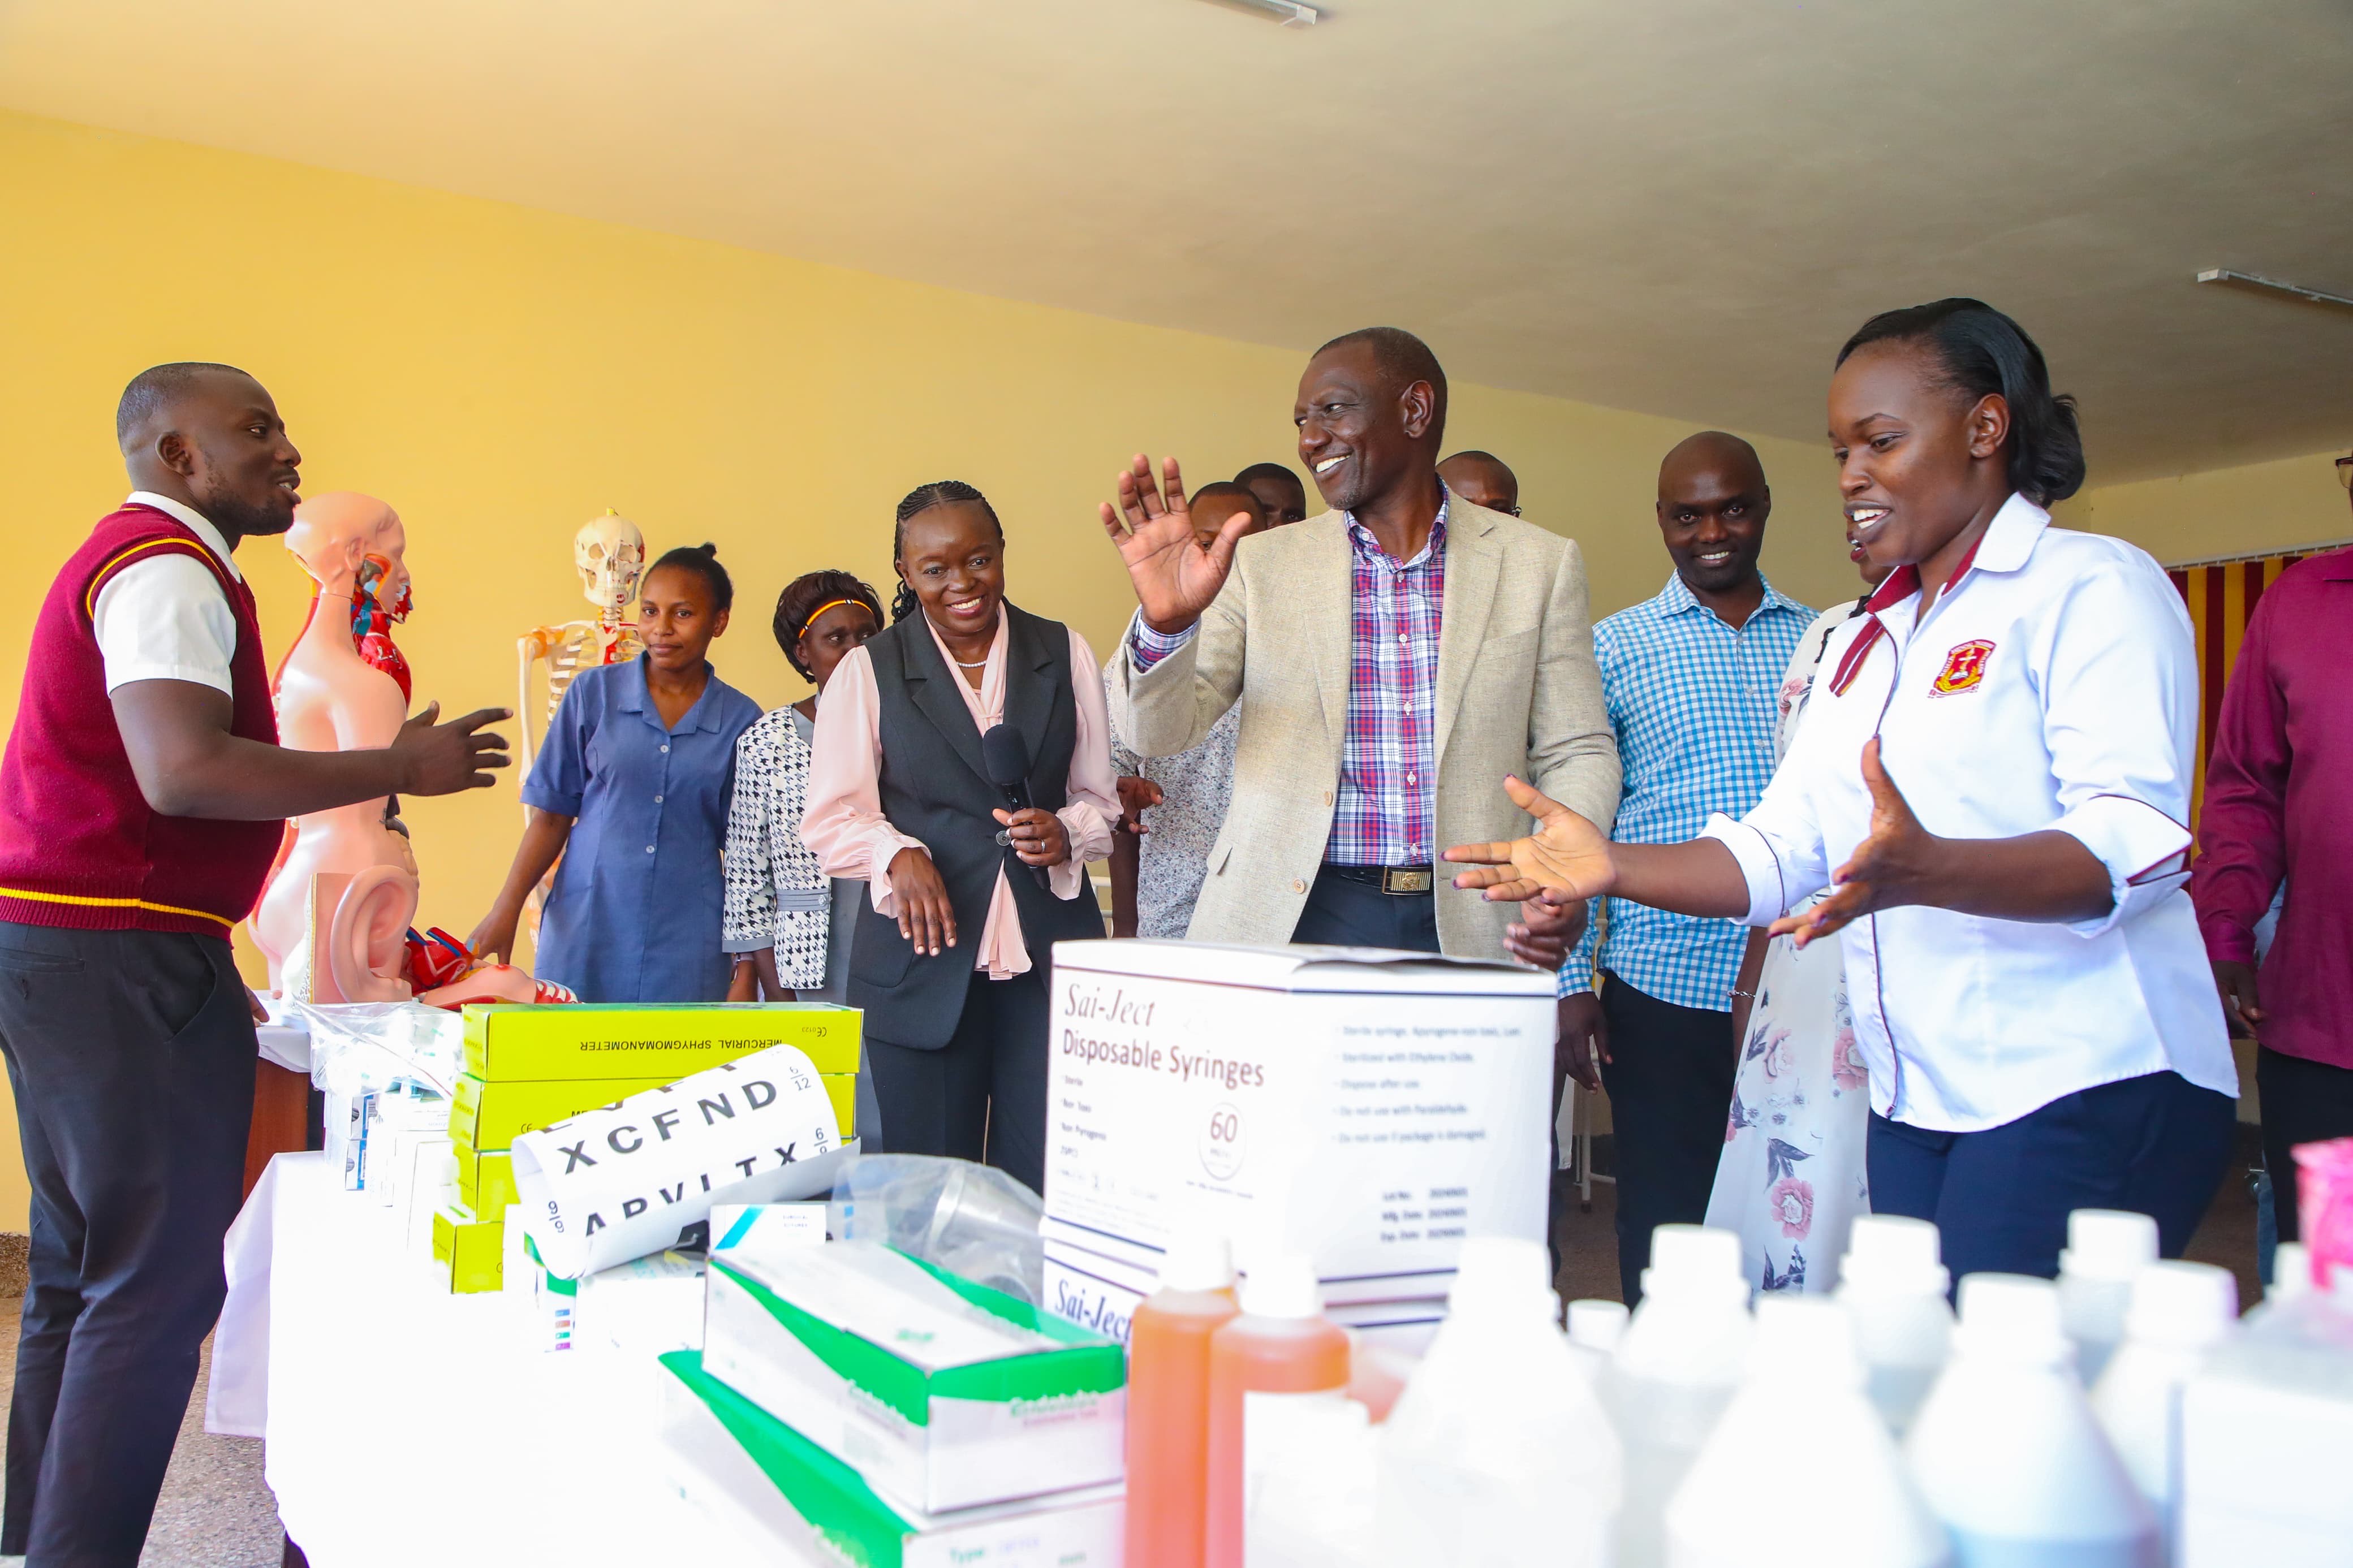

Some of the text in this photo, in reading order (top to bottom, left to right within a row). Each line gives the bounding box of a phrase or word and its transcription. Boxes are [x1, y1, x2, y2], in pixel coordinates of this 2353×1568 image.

[1065, 983, 1155, 1026] Sai-Ject
[579, 1039, 782, 1051] MERCURIAL SPHYGMOMANOMETER
[1063, 1028, 1264, 1091] Disposable Syringes
[1210, 1112, 1238, 1143] 60
